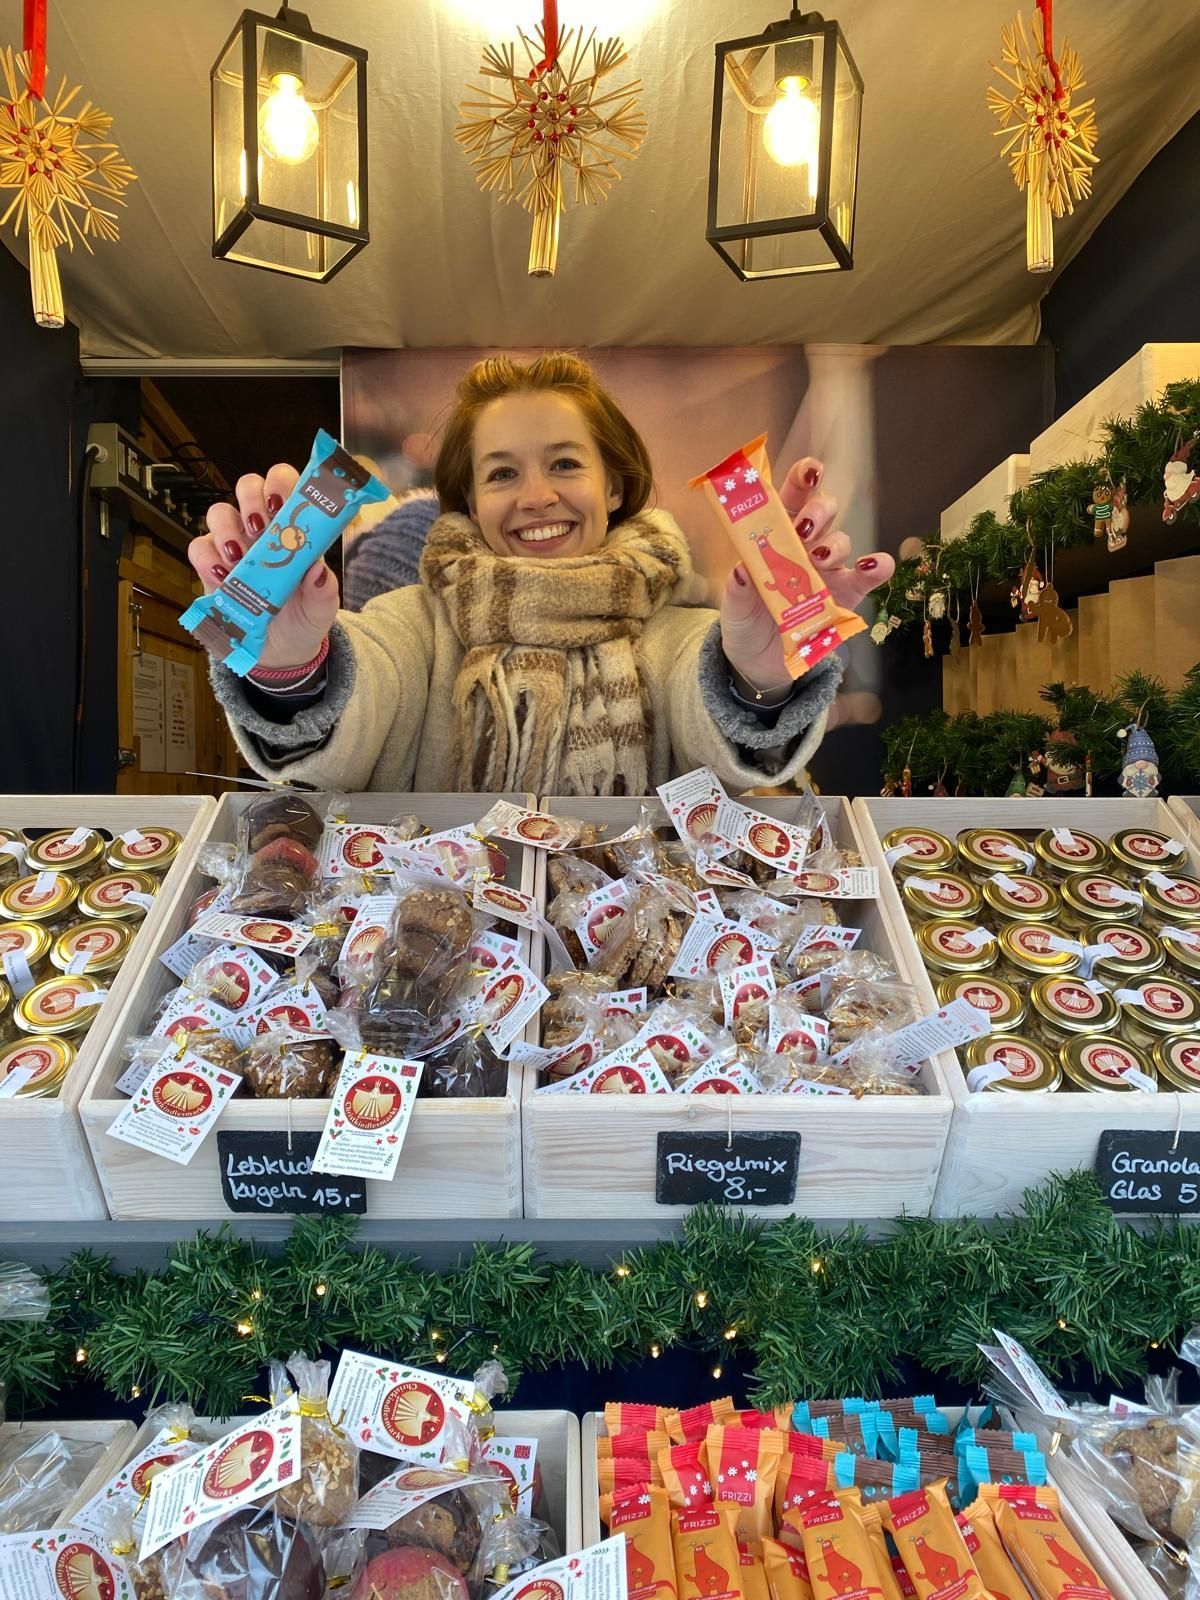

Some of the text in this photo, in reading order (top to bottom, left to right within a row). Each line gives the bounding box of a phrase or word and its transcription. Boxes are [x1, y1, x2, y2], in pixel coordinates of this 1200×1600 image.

[304, 484, 339, 513] FRIZZI
[730, 493, 763, 517] FRIZZI
[152, 1086, 207, 1118] Christkindlesmarkt
[345, 1101, 398, 1129] Christkindlesmarkt
[226, 1153, 343, 1178] Lebkuch
[665, 1153, 788, 1182] Riegelmix
[1111, 1151, 1200, 1175] Granola
[724, 1176, 767, 1200] 8,-
[1110, 1179, 1162, 1201] Glas
[382, 1383, 419, 1443] Christkindlesmarkt
[721, 1490, 752, 1502] FRIZZI
[615, 1510, 648, 1525] FRIZZI
[683, 1518, 717, 1530] FRIZZI
[806, 1511, 841, 1526] FRIZZI
[896, 1504, 927, 1526] FRIZZI
[1018, 1510, 1054, 1521] FRIZZI
